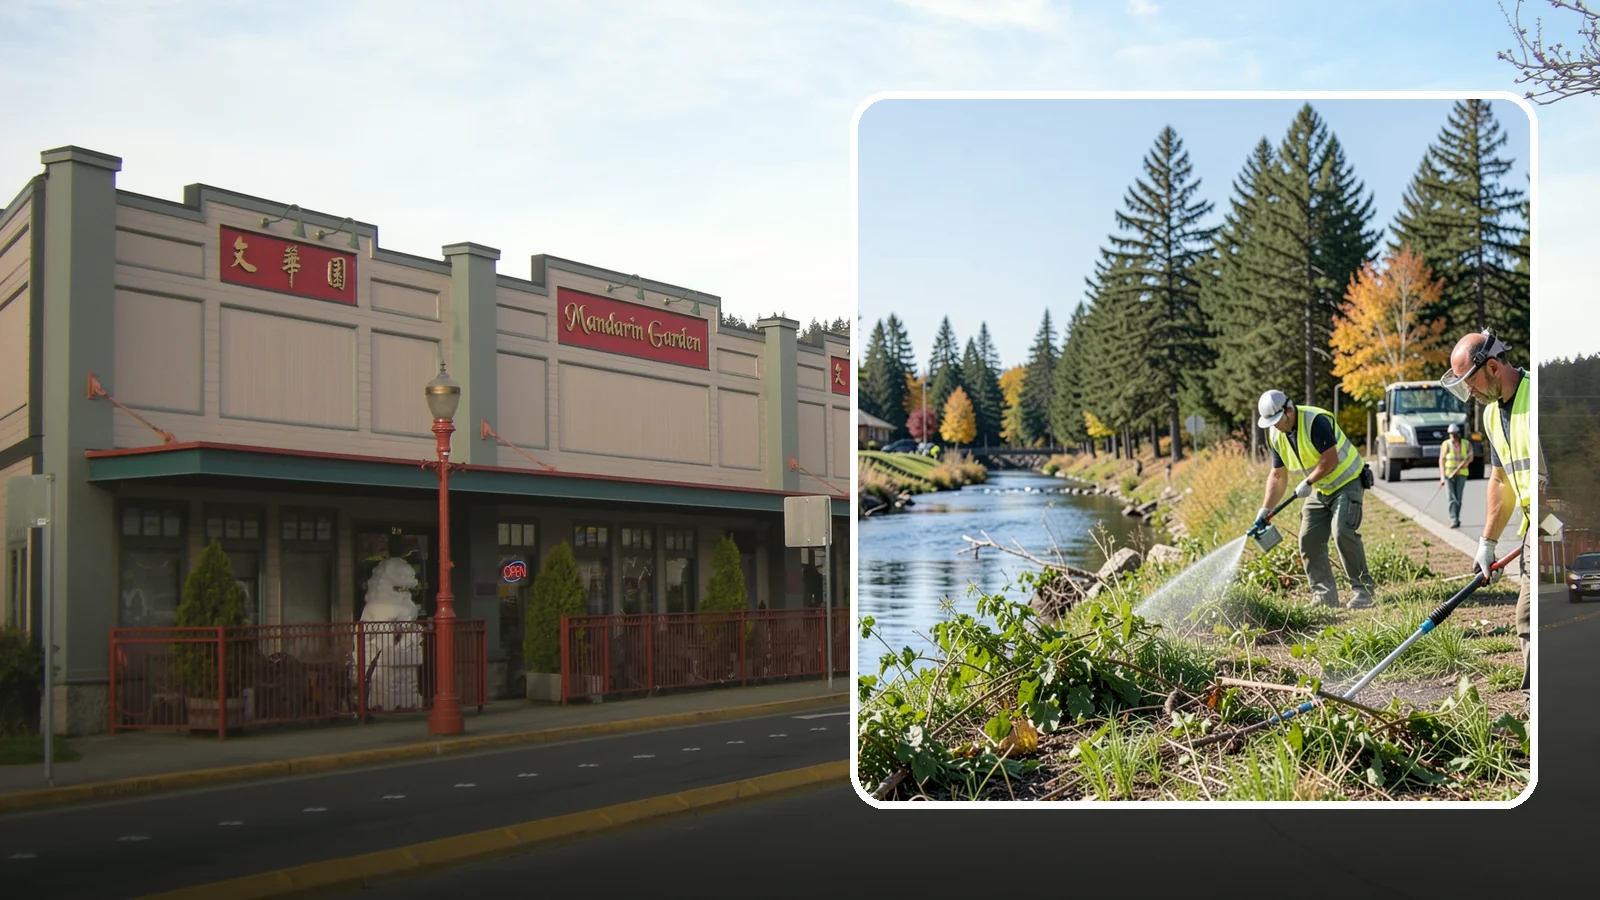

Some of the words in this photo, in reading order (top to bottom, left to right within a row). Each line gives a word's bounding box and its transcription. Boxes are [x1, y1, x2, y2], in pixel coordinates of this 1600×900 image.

[230, 235, 346, 291] 文華園
[564, 302, 644, 341] Mandarin
[647, 320, 701, 352] Garden
[503, 565, 527, 578] OPEN
